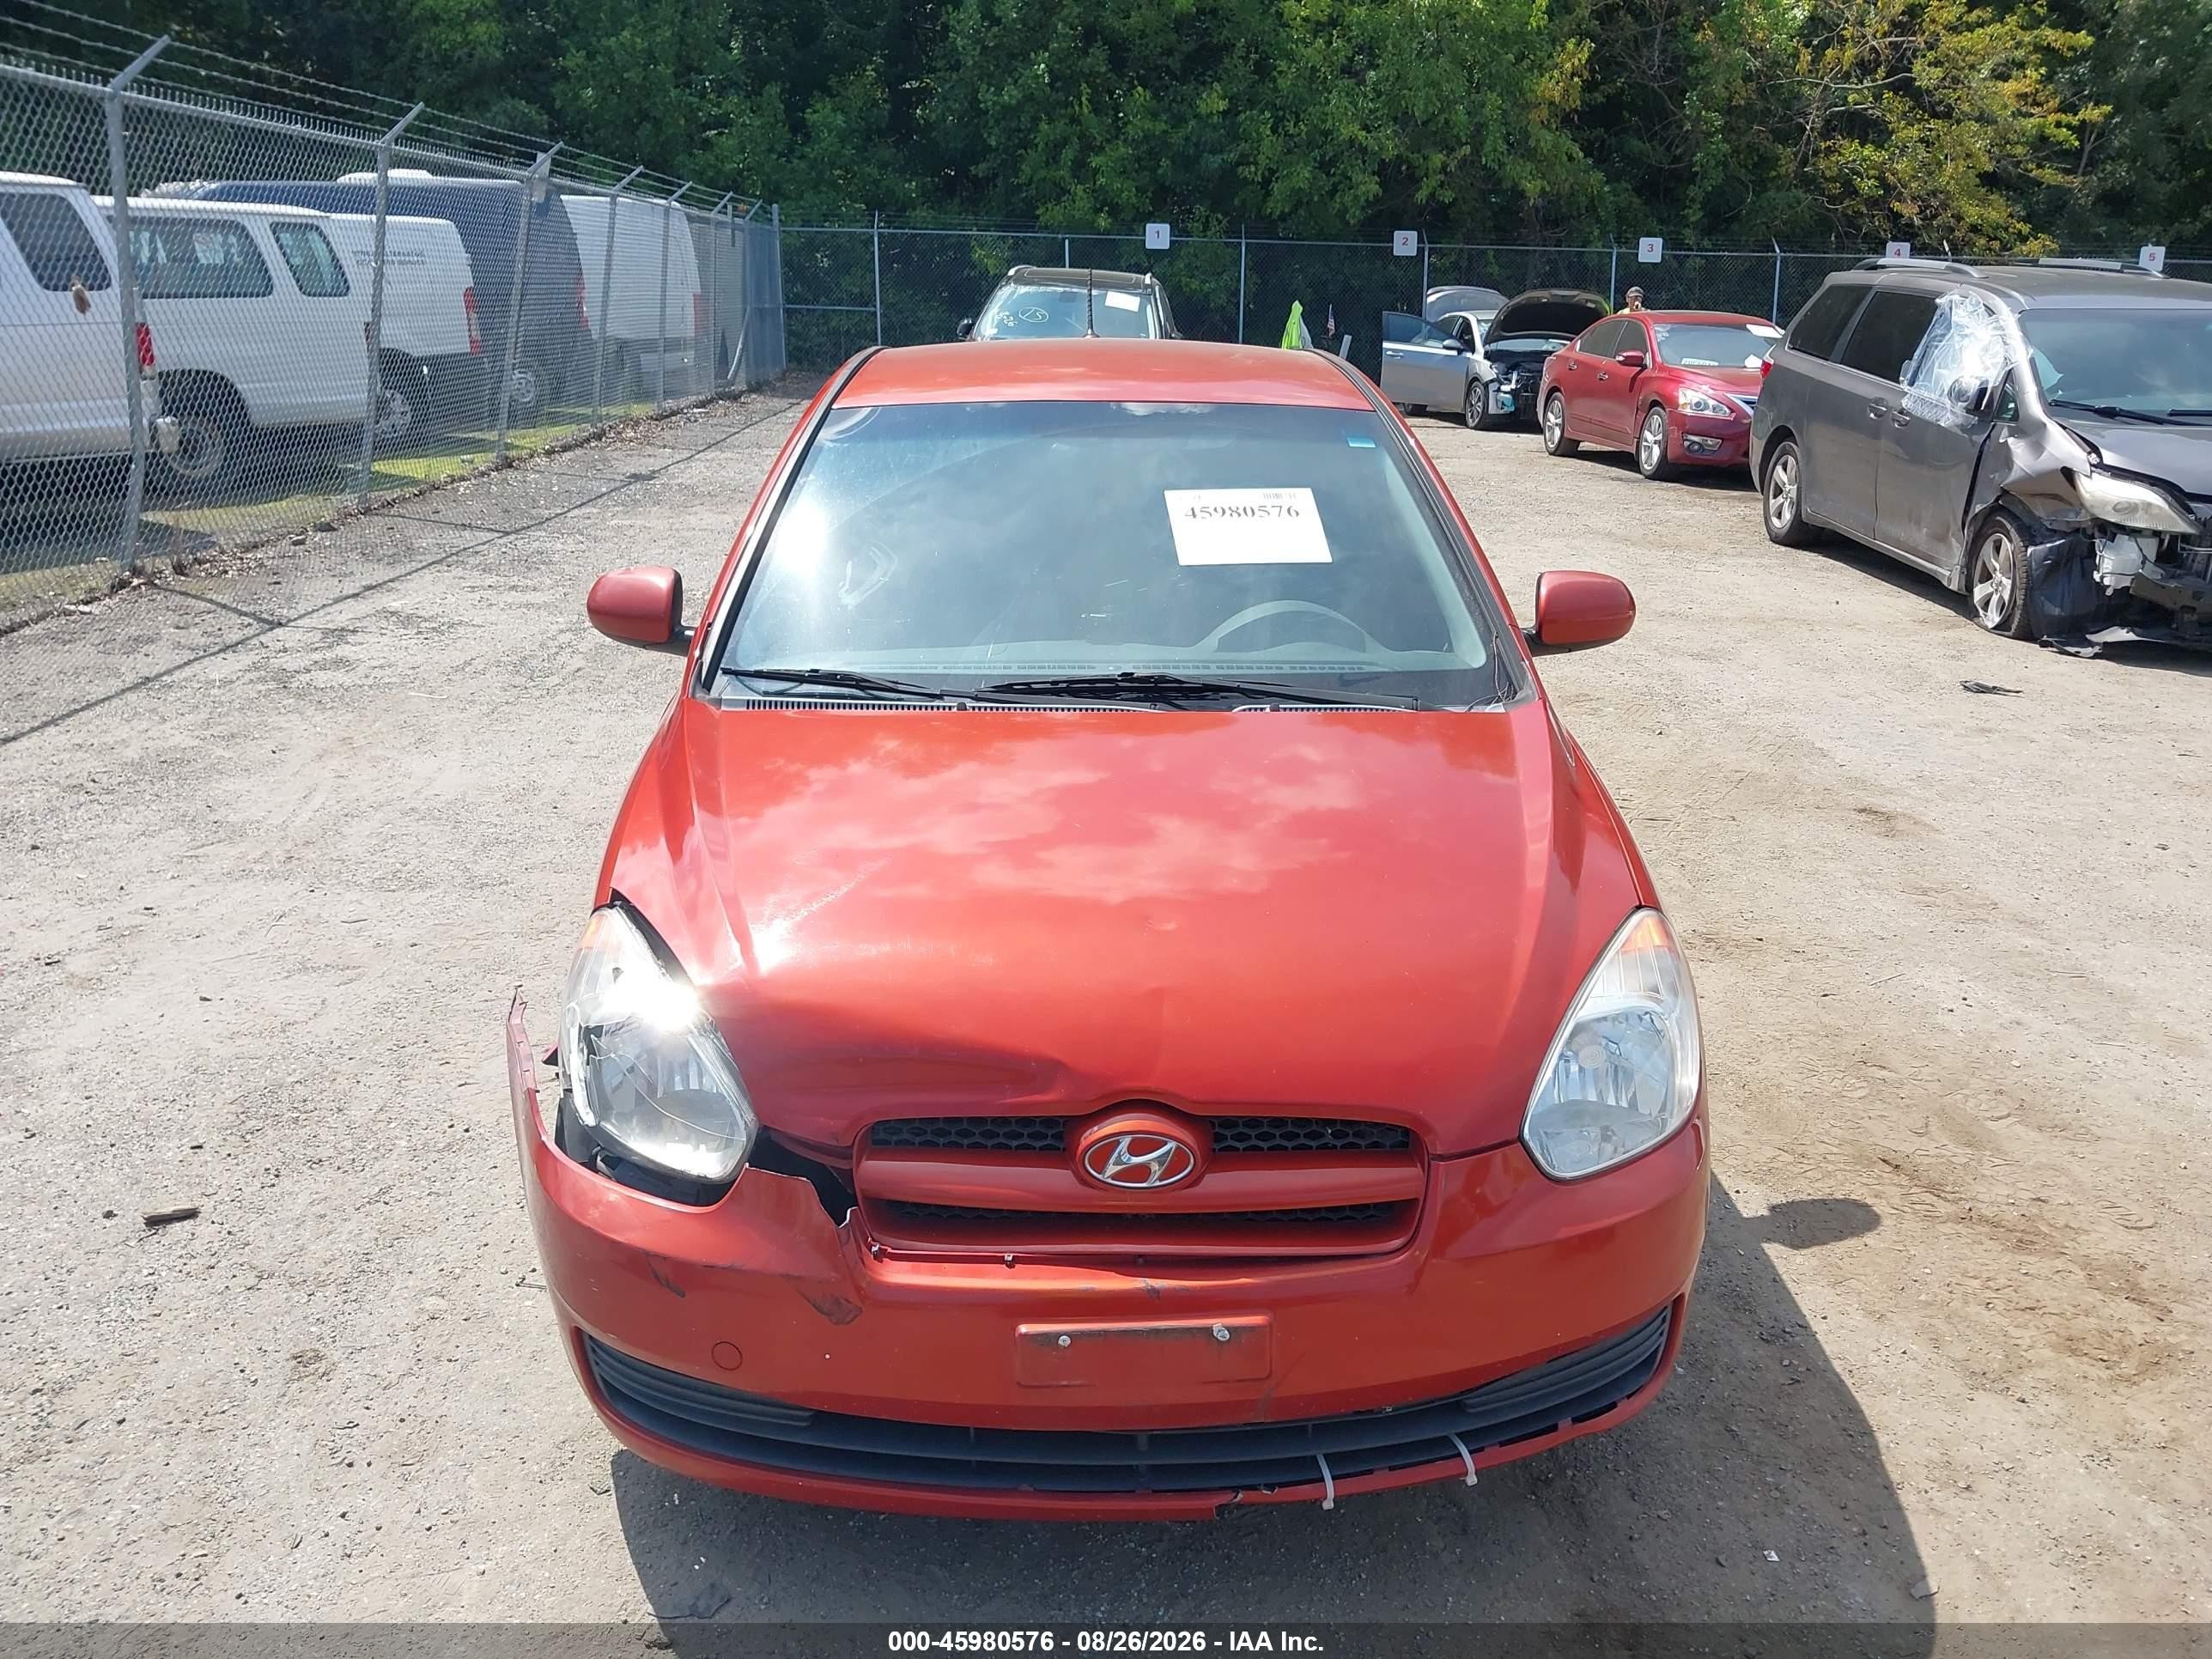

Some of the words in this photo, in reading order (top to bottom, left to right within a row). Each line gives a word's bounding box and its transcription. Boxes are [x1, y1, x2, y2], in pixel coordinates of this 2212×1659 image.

[1155, 230, 1160, 240] 1
[1401, 236, 1409, 246] 2
[1647, 243, 1654, 253] 3
[1894, 248, 1901, 257] 4
[2148, 252, 2156, 262] 5
[1184, 505, 1300, 520] 45980576
